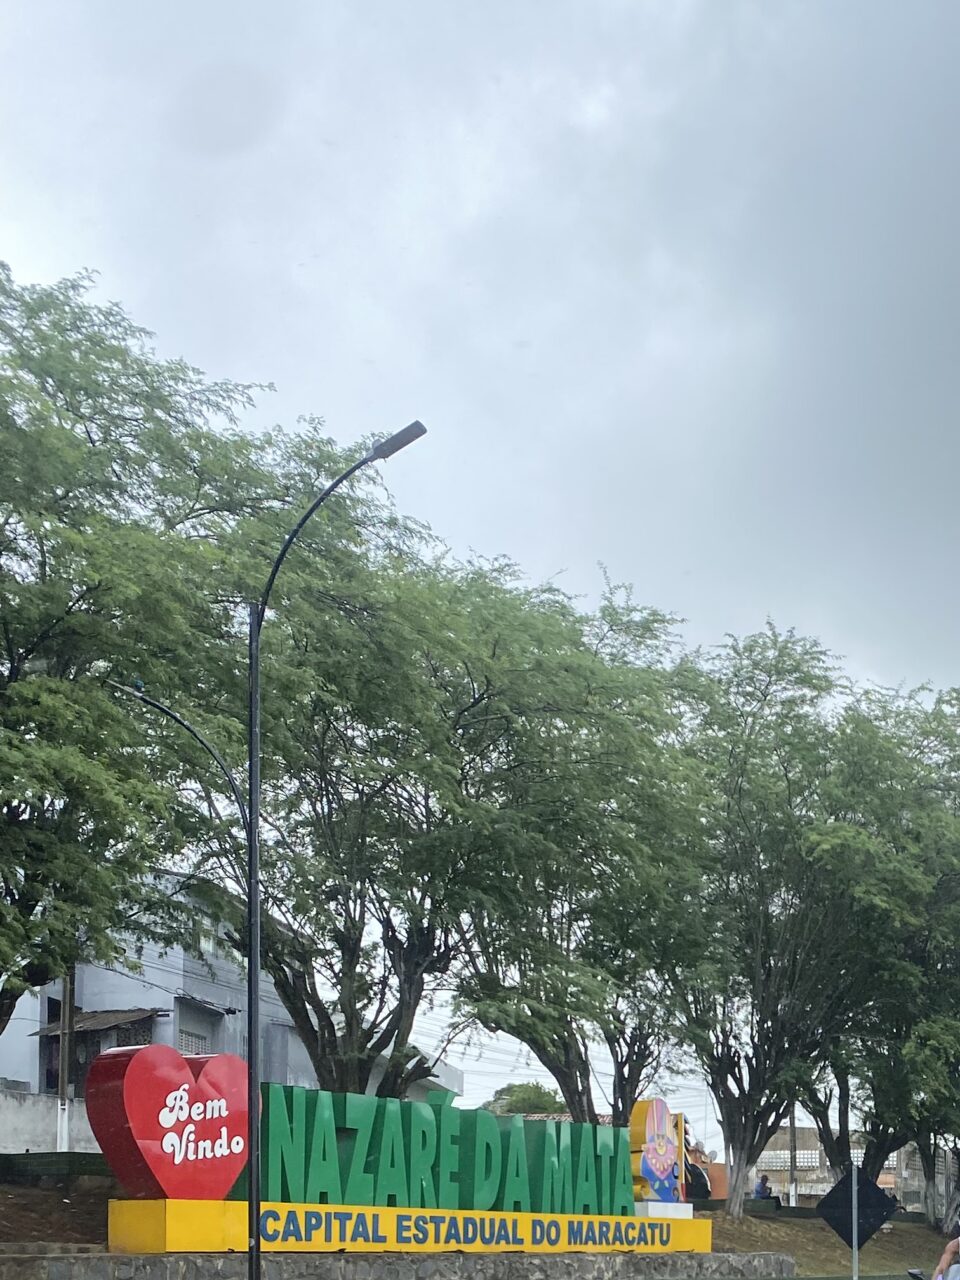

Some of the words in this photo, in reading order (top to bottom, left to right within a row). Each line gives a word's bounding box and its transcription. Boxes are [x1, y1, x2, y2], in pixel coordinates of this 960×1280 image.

[158, 1083, 229, 1129] Bem
[161, 1124, 246, 1166] Vindo
[268, 1083, 461, 1210] NAZARÉ
[474, 1110, 532, 1212] DA
[543, 1121, 636, 1217] MATA
[260, 1210, 388, 1244] CAPITAL
[396, 1214, 525, 1246] ESTADUAL
[531, 1221, 562, 1246] DO
[567, 1223, 672, 1248] MARACATU
